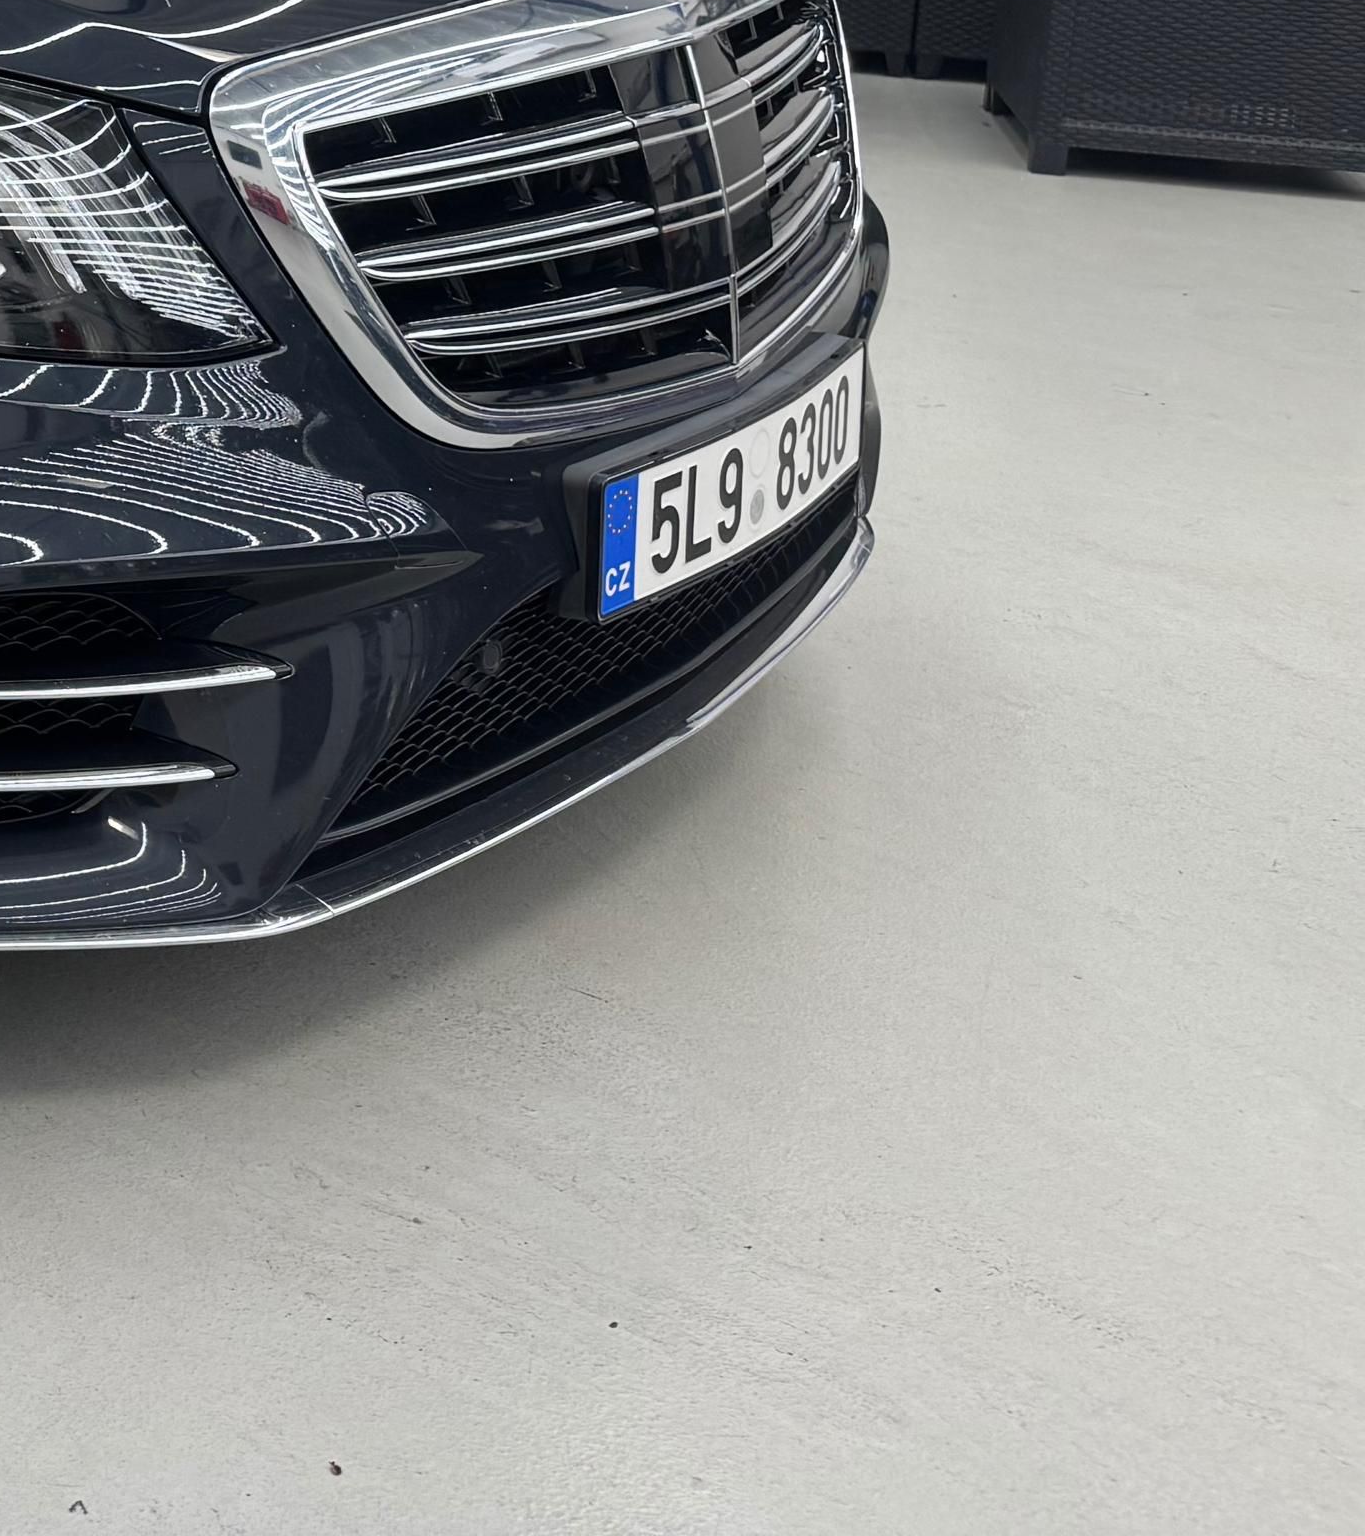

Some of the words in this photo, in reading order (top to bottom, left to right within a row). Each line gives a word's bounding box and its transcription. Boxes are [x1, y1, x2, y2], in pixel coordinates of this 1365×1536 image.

[651, 447, 744, 575] 5L9
[776, 375, 850, 511] 8300
[604, 561, 632, 597] CZ
